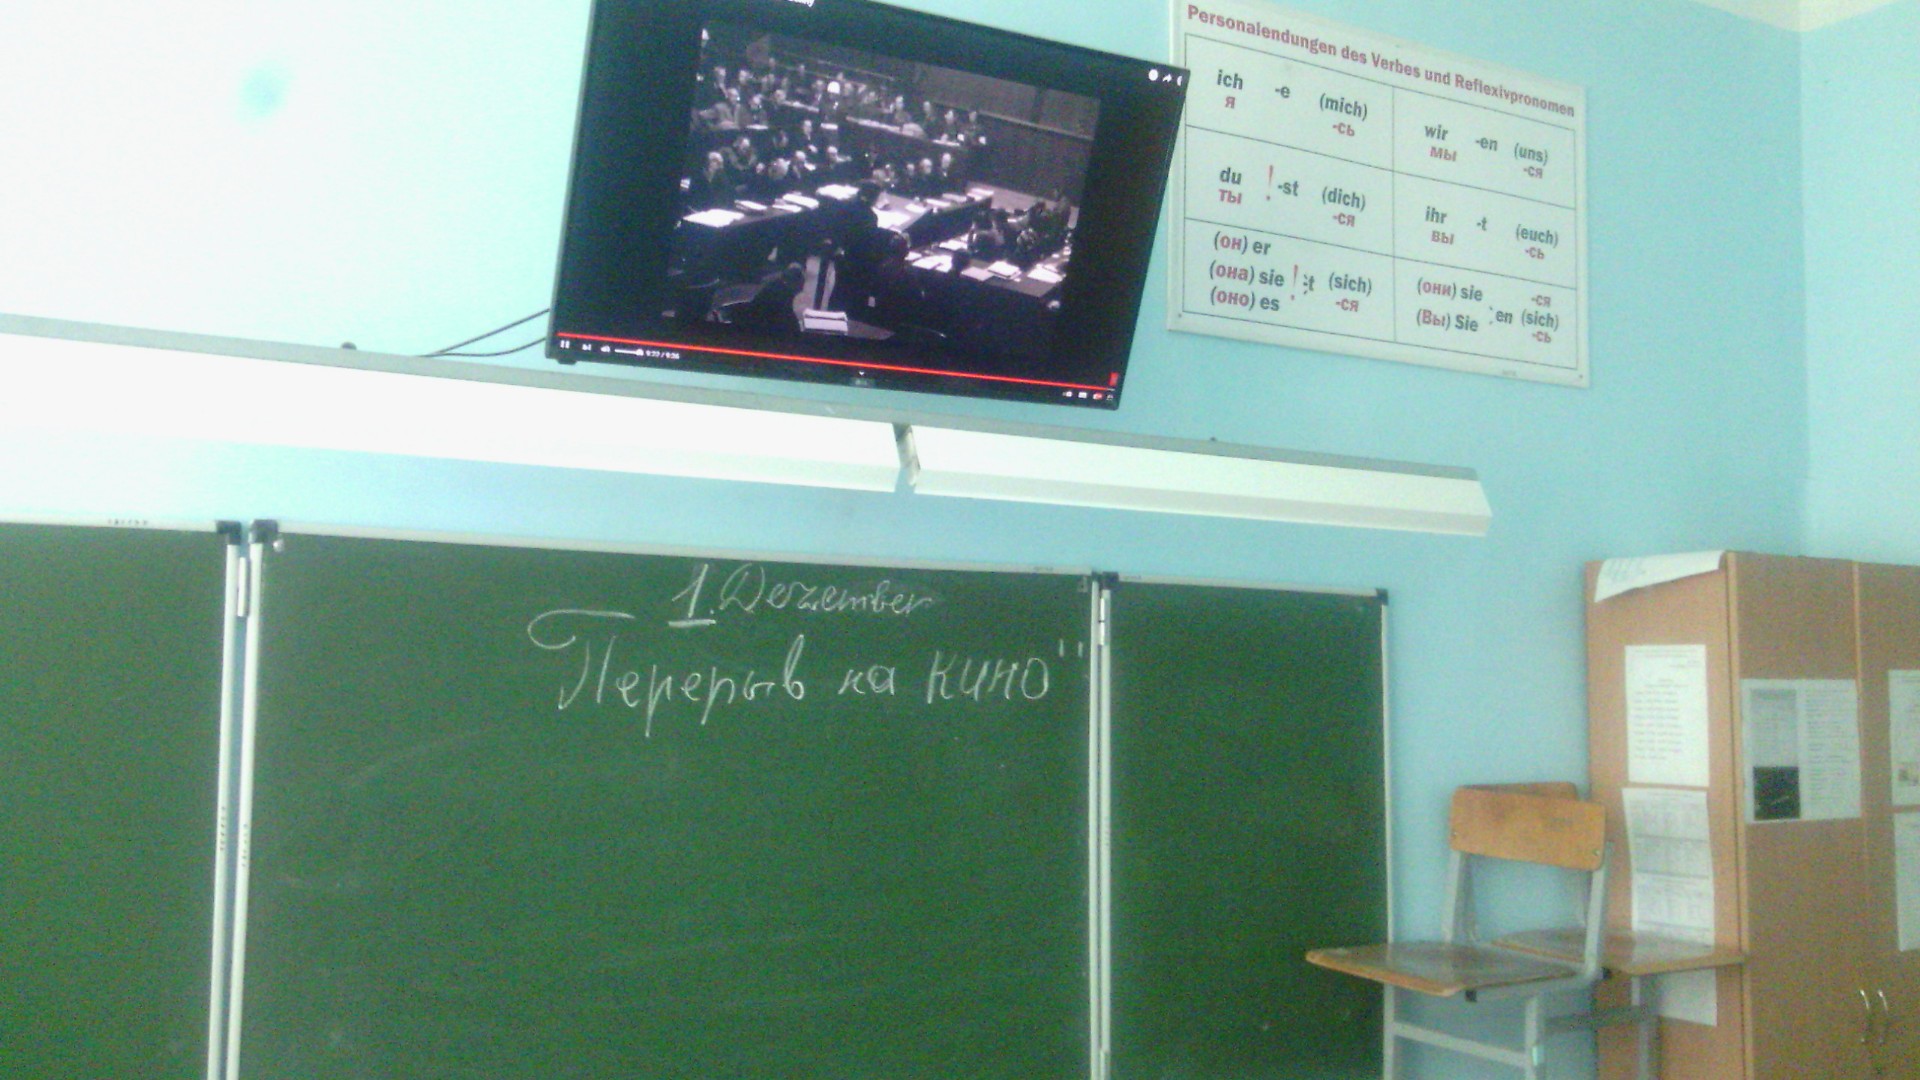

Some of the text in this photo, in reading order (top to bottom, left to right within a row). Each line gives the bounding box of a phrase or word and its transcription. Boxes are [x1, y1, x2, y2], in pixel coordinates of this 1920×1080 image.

[1187, 4, 1575, 117] Personalendungen des Verbes und Reflexivpronomen
[1217, 69, 1243, 90] ich
[1319, 93, 1368, 121] (mich)
[1424, 124, 1449, 141] wir
[1514, 142, 1549, 167] (uns)
[1219, 167, 1242, 185] du
[1321, 187, 1366, 212] (dich)
[1425, 206, 1447, 224] ihr
[1515, 224, 1559, 249] (euch)
[1252, 241, 1272, 256] er
[1209, 260, 1255, 286] (она)
[1258, 269, 1285, 287] sie
[1329, 272, 1373, 297] (sich)
[1460, 285, 1483, 302] sie
[1259, 296, 1281, 312] es
[1455, 314, 1479, 333] Sie
[1521, 309, 1559, 332] (sich)
